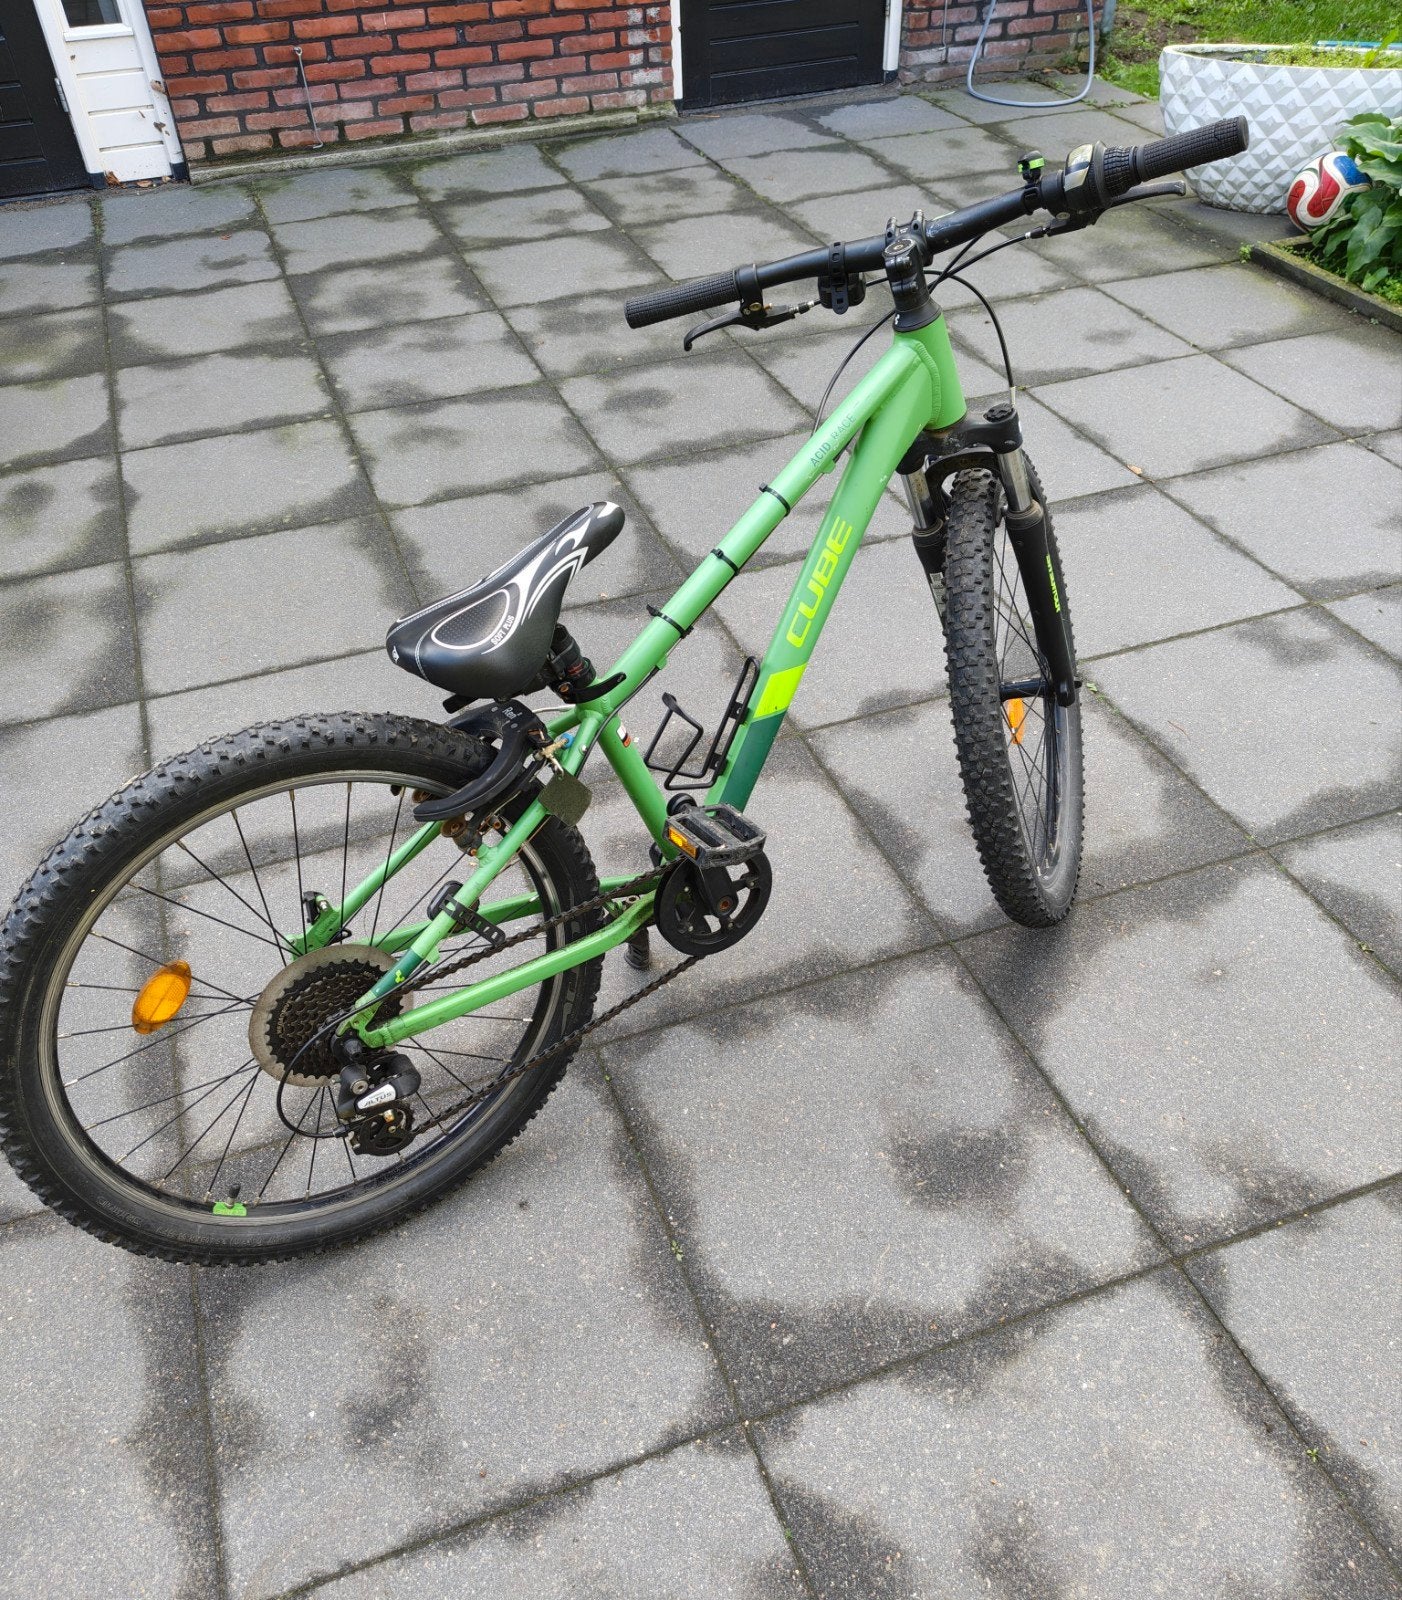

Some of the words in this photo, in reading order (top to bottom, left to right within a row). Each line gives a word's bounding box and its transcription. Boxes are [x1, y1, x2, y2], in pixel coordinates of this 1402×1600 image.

[810, 442, 832, 467] ACID
[830, 415, 857, 440] RACE
[786, 515, 853, 648] CUBE
[490, 629, 507, 646] SOFT
[502, 614, 515, 630] PLUS
[364, 1092, 392, 1107] ALTUS
